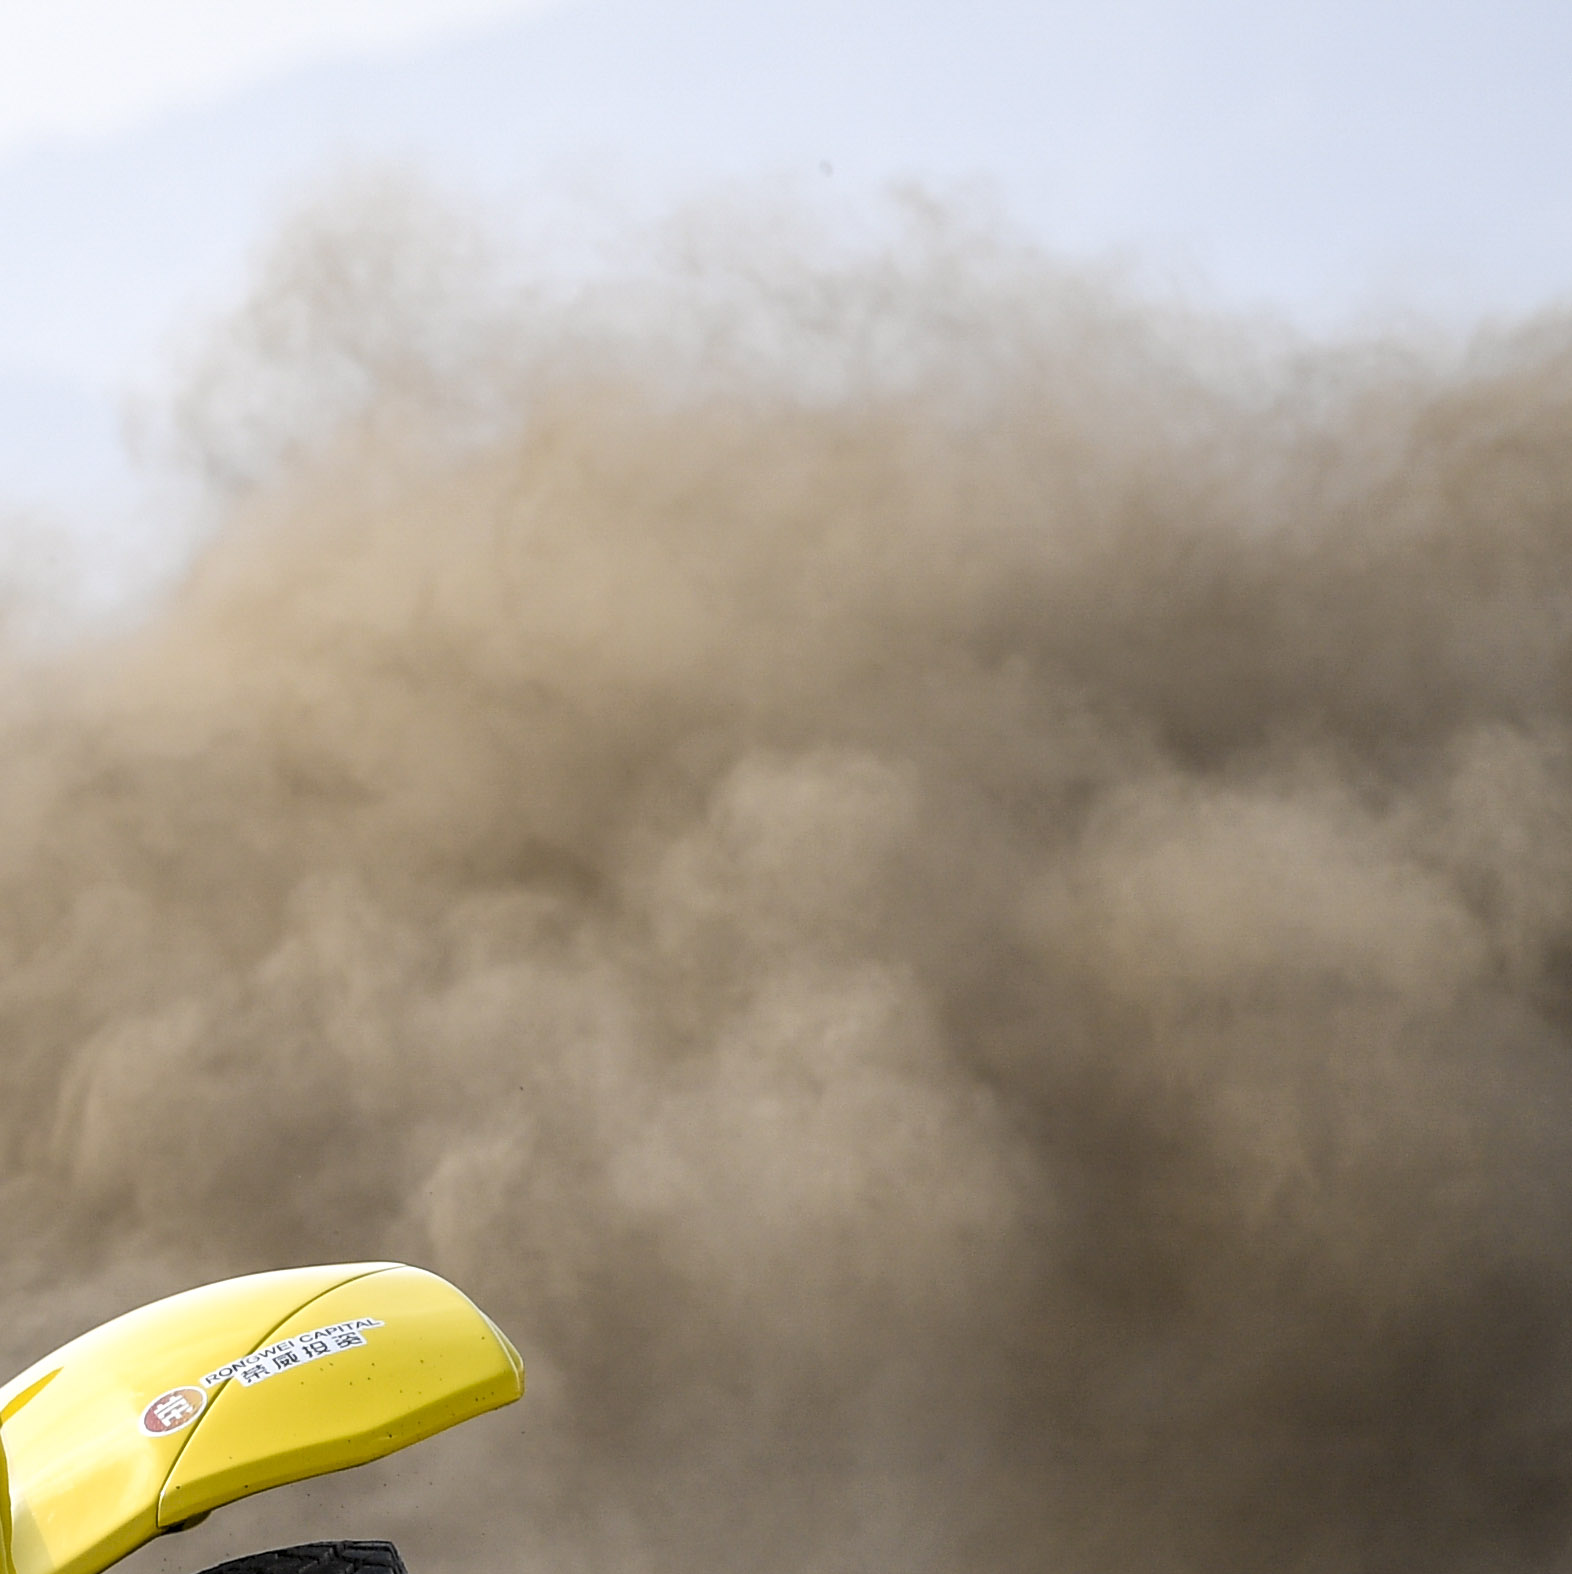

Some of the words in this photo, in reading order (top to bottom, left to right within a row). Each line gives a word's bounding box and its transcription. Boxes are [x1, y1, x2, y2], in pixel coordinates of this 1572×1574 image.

[205, 1340, 295, 1385] RONGWEI
[299, 1318, 381, 1343] CAPITAL
[241, 1331, 363, 1384] 荣威投资
